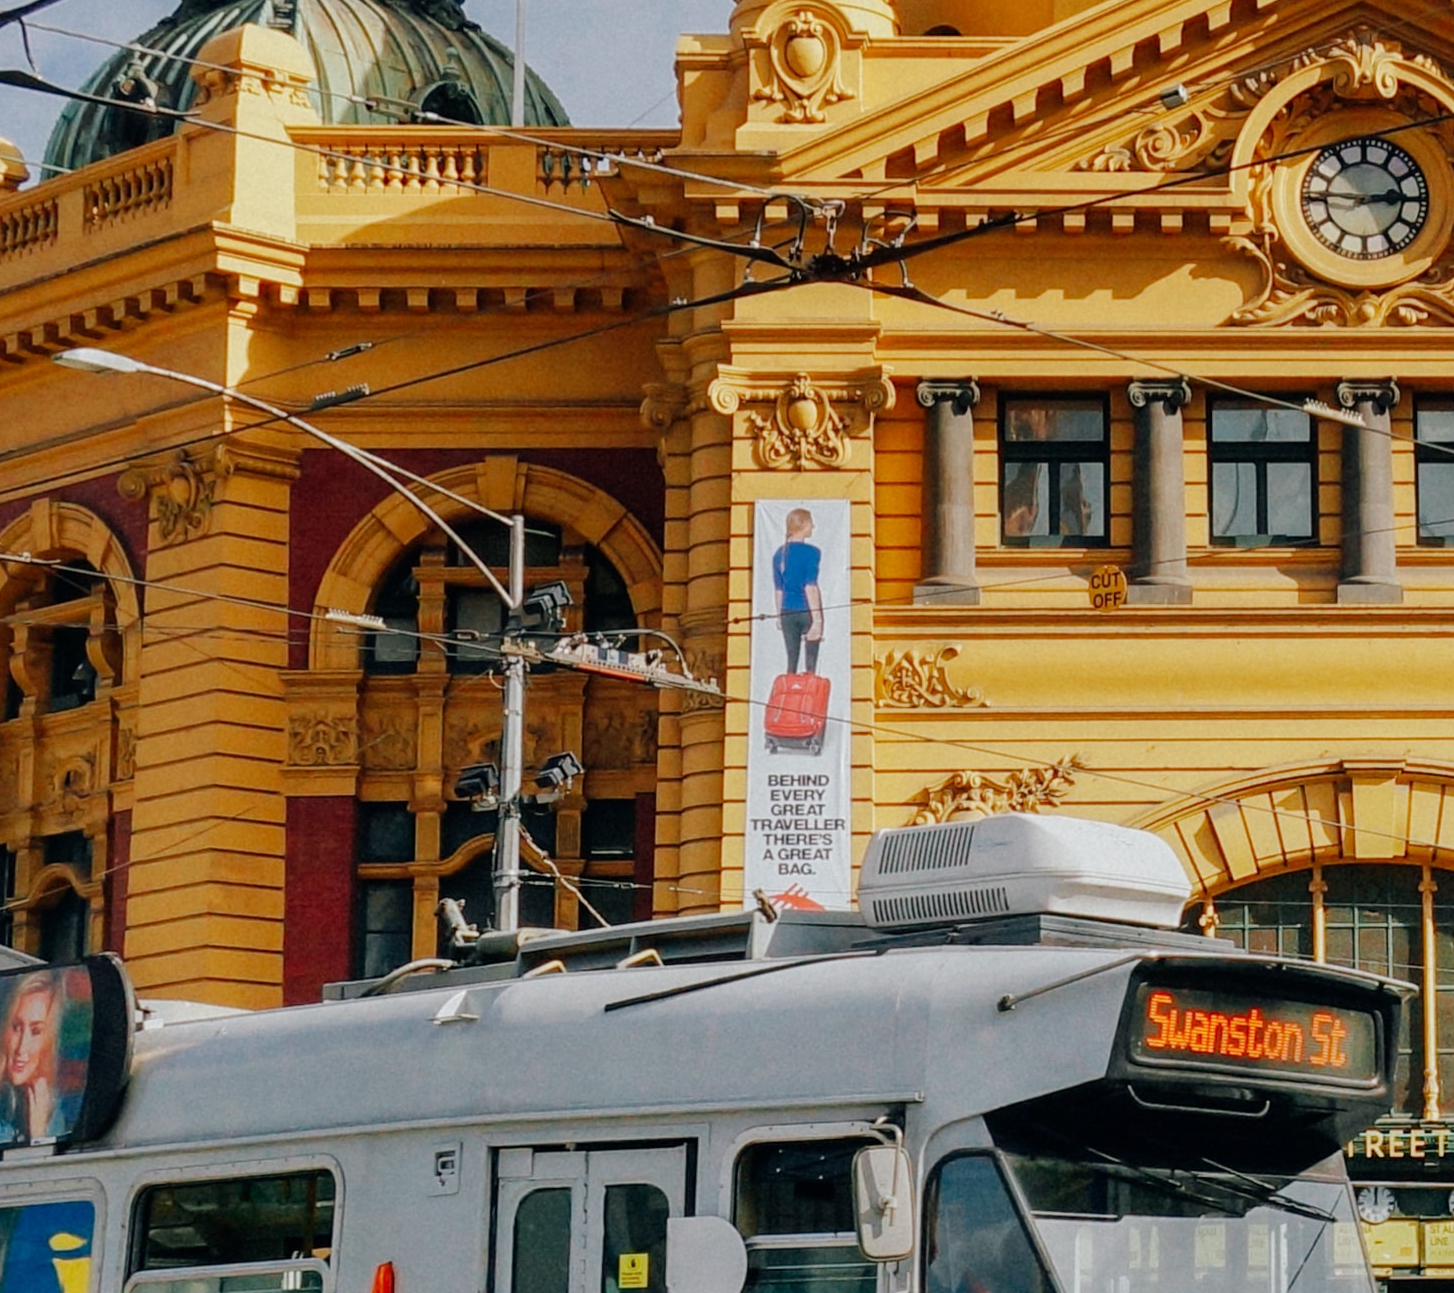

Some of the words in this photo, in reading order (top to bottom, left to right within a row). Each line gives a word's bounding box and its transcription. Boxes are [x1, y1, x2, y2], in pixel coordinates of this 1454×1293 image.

[1091, 572, 1120, 589] CUT
[1093, 591, 1121, 609] OFF
[768, 775, 830, 786] BEHIND
[770, 789, 825, 801] EVERY
[770, 804, 826, 816] GREAT
[750, 819, 846, 831] TRAVELLER
[763, 834, 833, 845] THERE'S
[762, 848, 774, 860] A
[777, 848, 832, 861] GREAT
[778, 863, 816, 875] BAG.
[1146, 992, 1303, 1062] Swanston
[1310, 1013, 1348, 1068] St
[1429, 1225, 1441, 1234] ST
[1430, 1237, 1448, 1246] LINE
